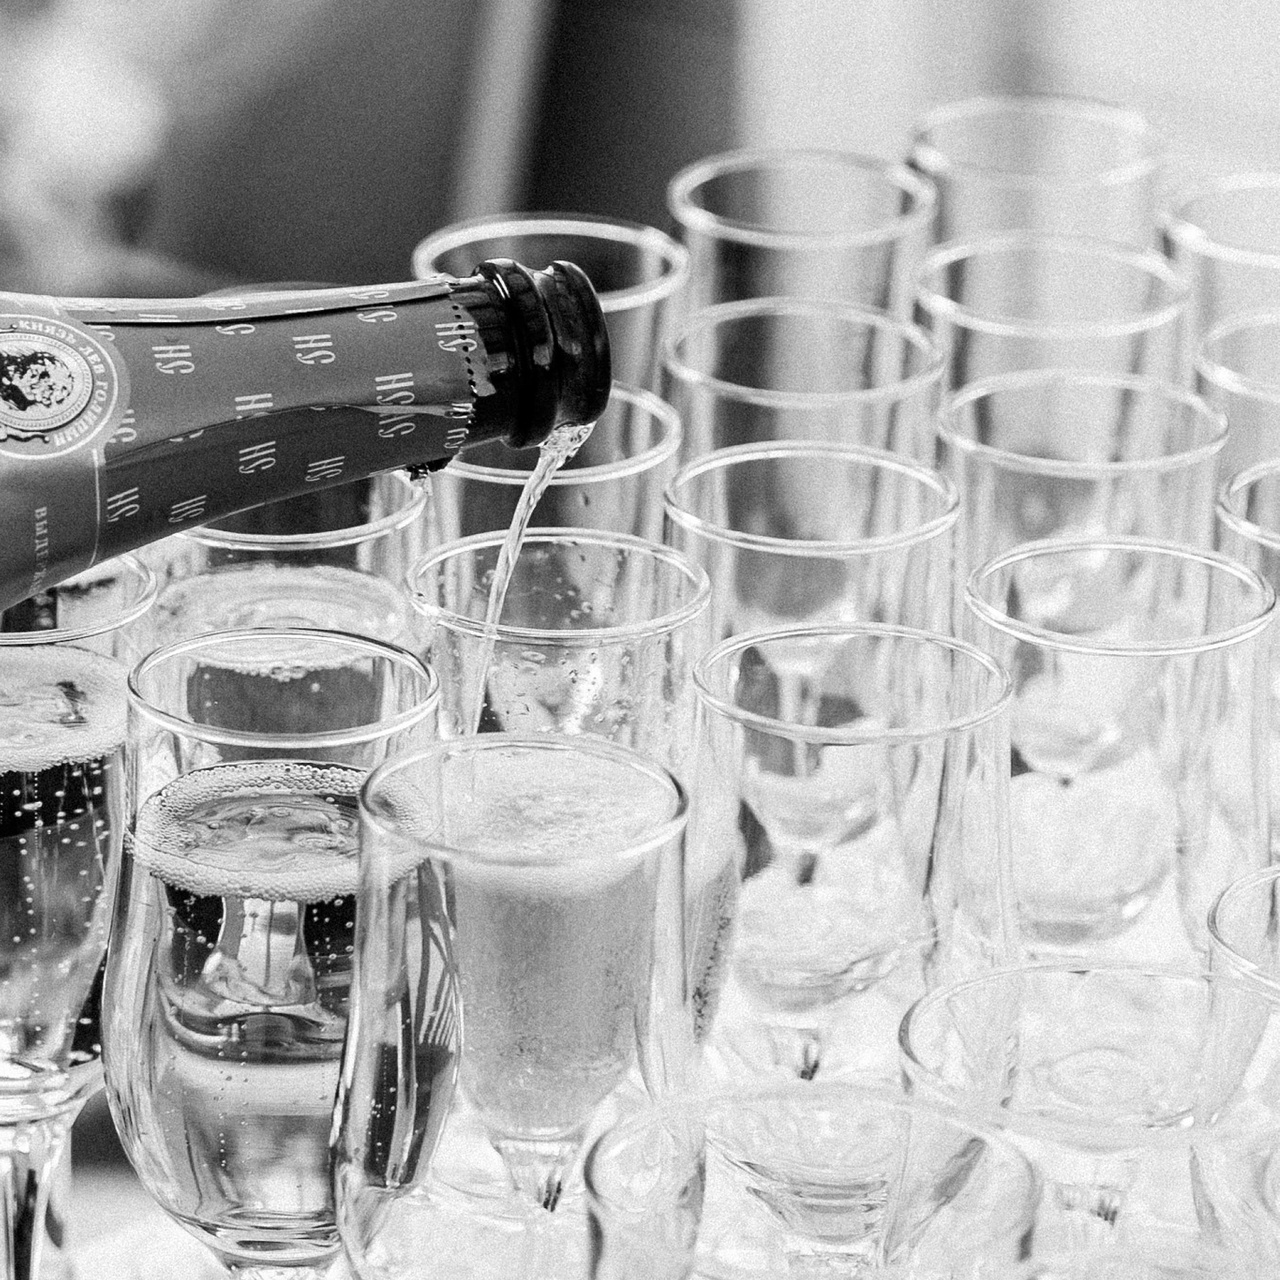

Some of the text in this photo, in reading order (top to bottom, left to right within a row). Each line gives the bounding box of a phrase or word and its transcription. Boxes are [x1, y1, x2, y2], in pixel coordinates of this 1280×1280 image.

[19, 319, 78, 345] КНЯЗЬ
[78, 344, 106, 375] ЛЕВ
[151, 344, 196, 375] НС
[292, 333, 337, 365] НС
[53, 379, 109, 447] ГОЛИЦЫН
[238, 441, 277, 475] НС
